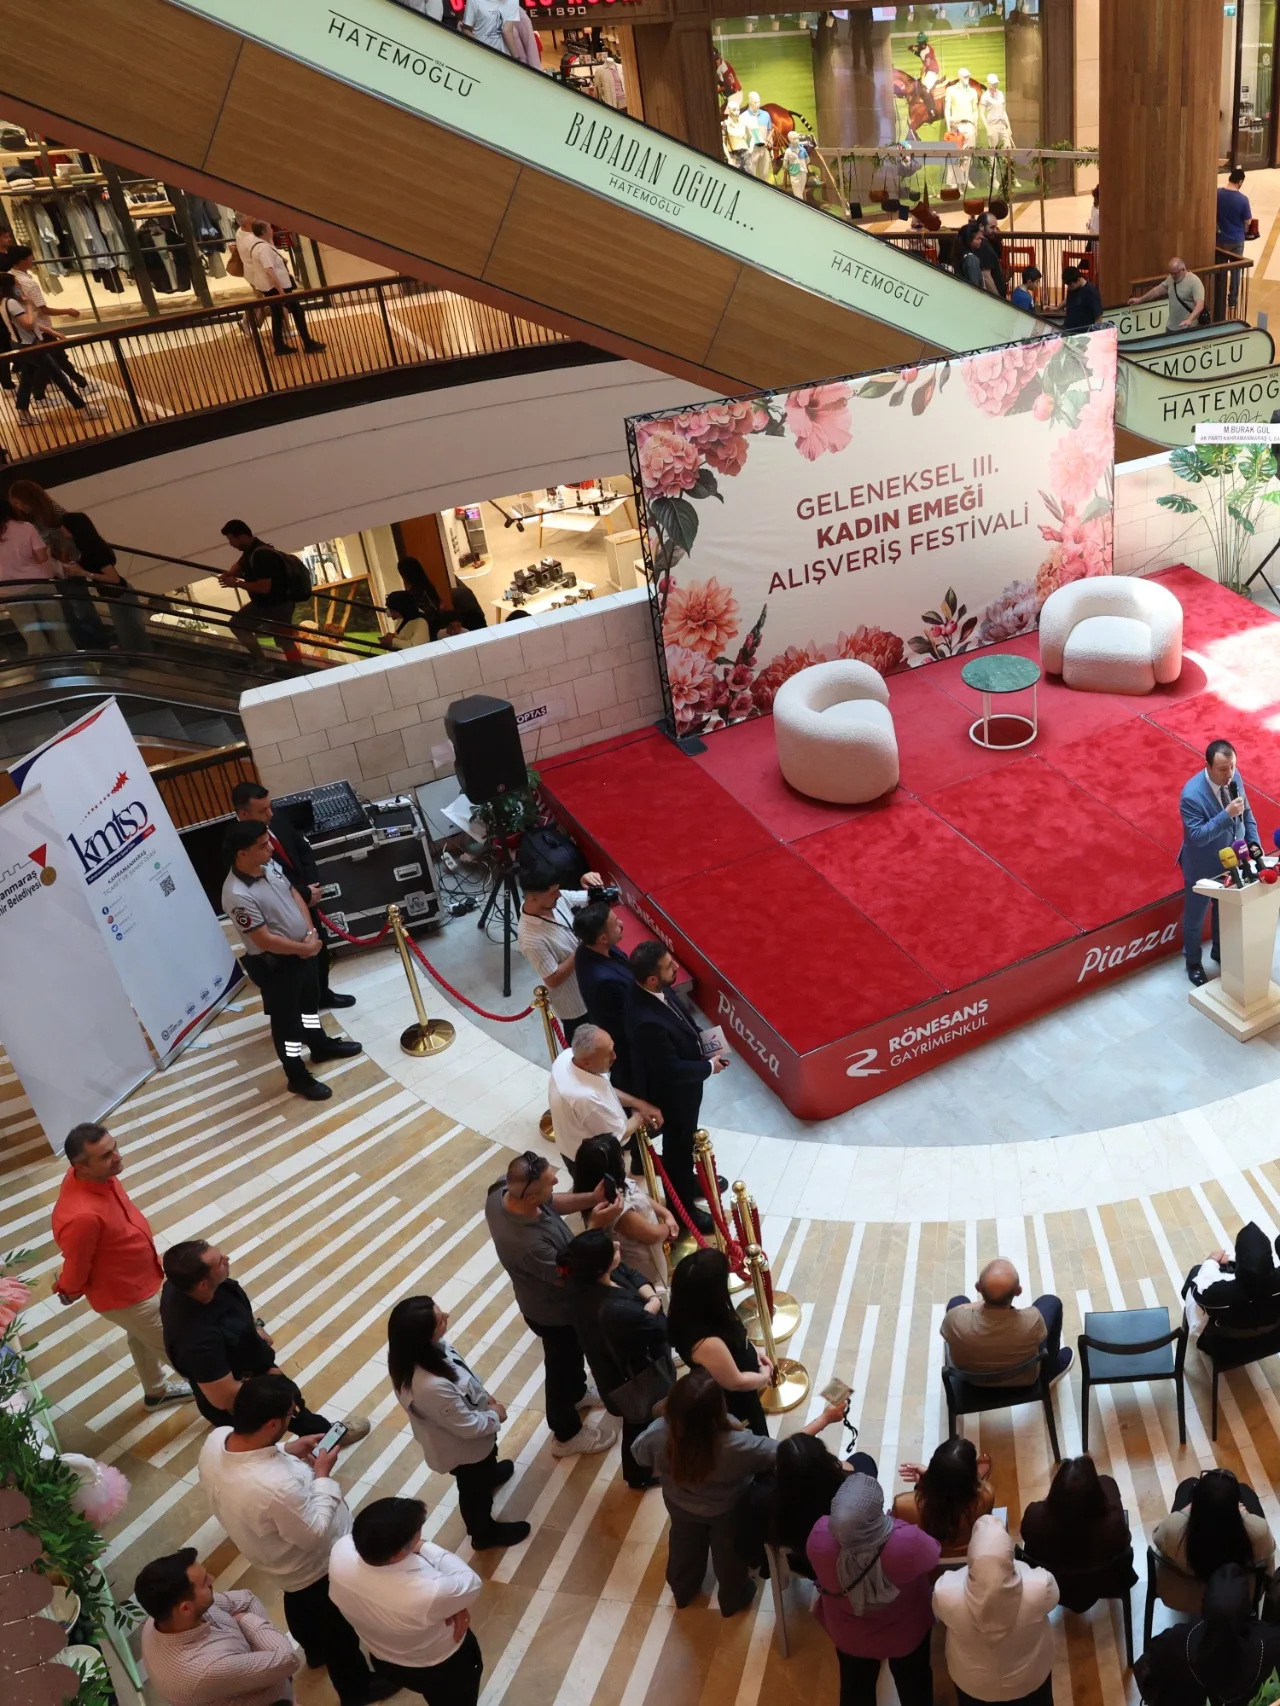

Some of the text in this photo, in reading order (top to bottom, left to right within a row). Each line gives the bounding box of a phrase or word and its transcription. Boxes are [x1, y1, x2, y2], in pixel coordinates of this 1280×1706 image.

[548, 6, 587, 16] 1890
[328, 18, 473, 97] HATEMOGLU
[565, 112, 754, 231] BABADAN OĞULA...
[609, 177, 682, 216] HATEMOGLU
[831, 255, 924, 307] HATEMOGLU
[1256, 425, 1271, 434] GÜL
[796, 454, 999, 521] GELENEKSEL III.
[817, 483, 984, 549] KADIN EMEĞİ
[768, 502, 1029, 595] ALIŞVERİŞ FESTİVALİ
[7, 879, 42, 909] Belediyesi
[1077, 921, 1178, 983] Piazza
[717, 989, 779, 1078] Piazza
[889, 998, 989, 1053] RÖNESANS
[890, 1016, 988, 1067] GAYRİMENKUL
